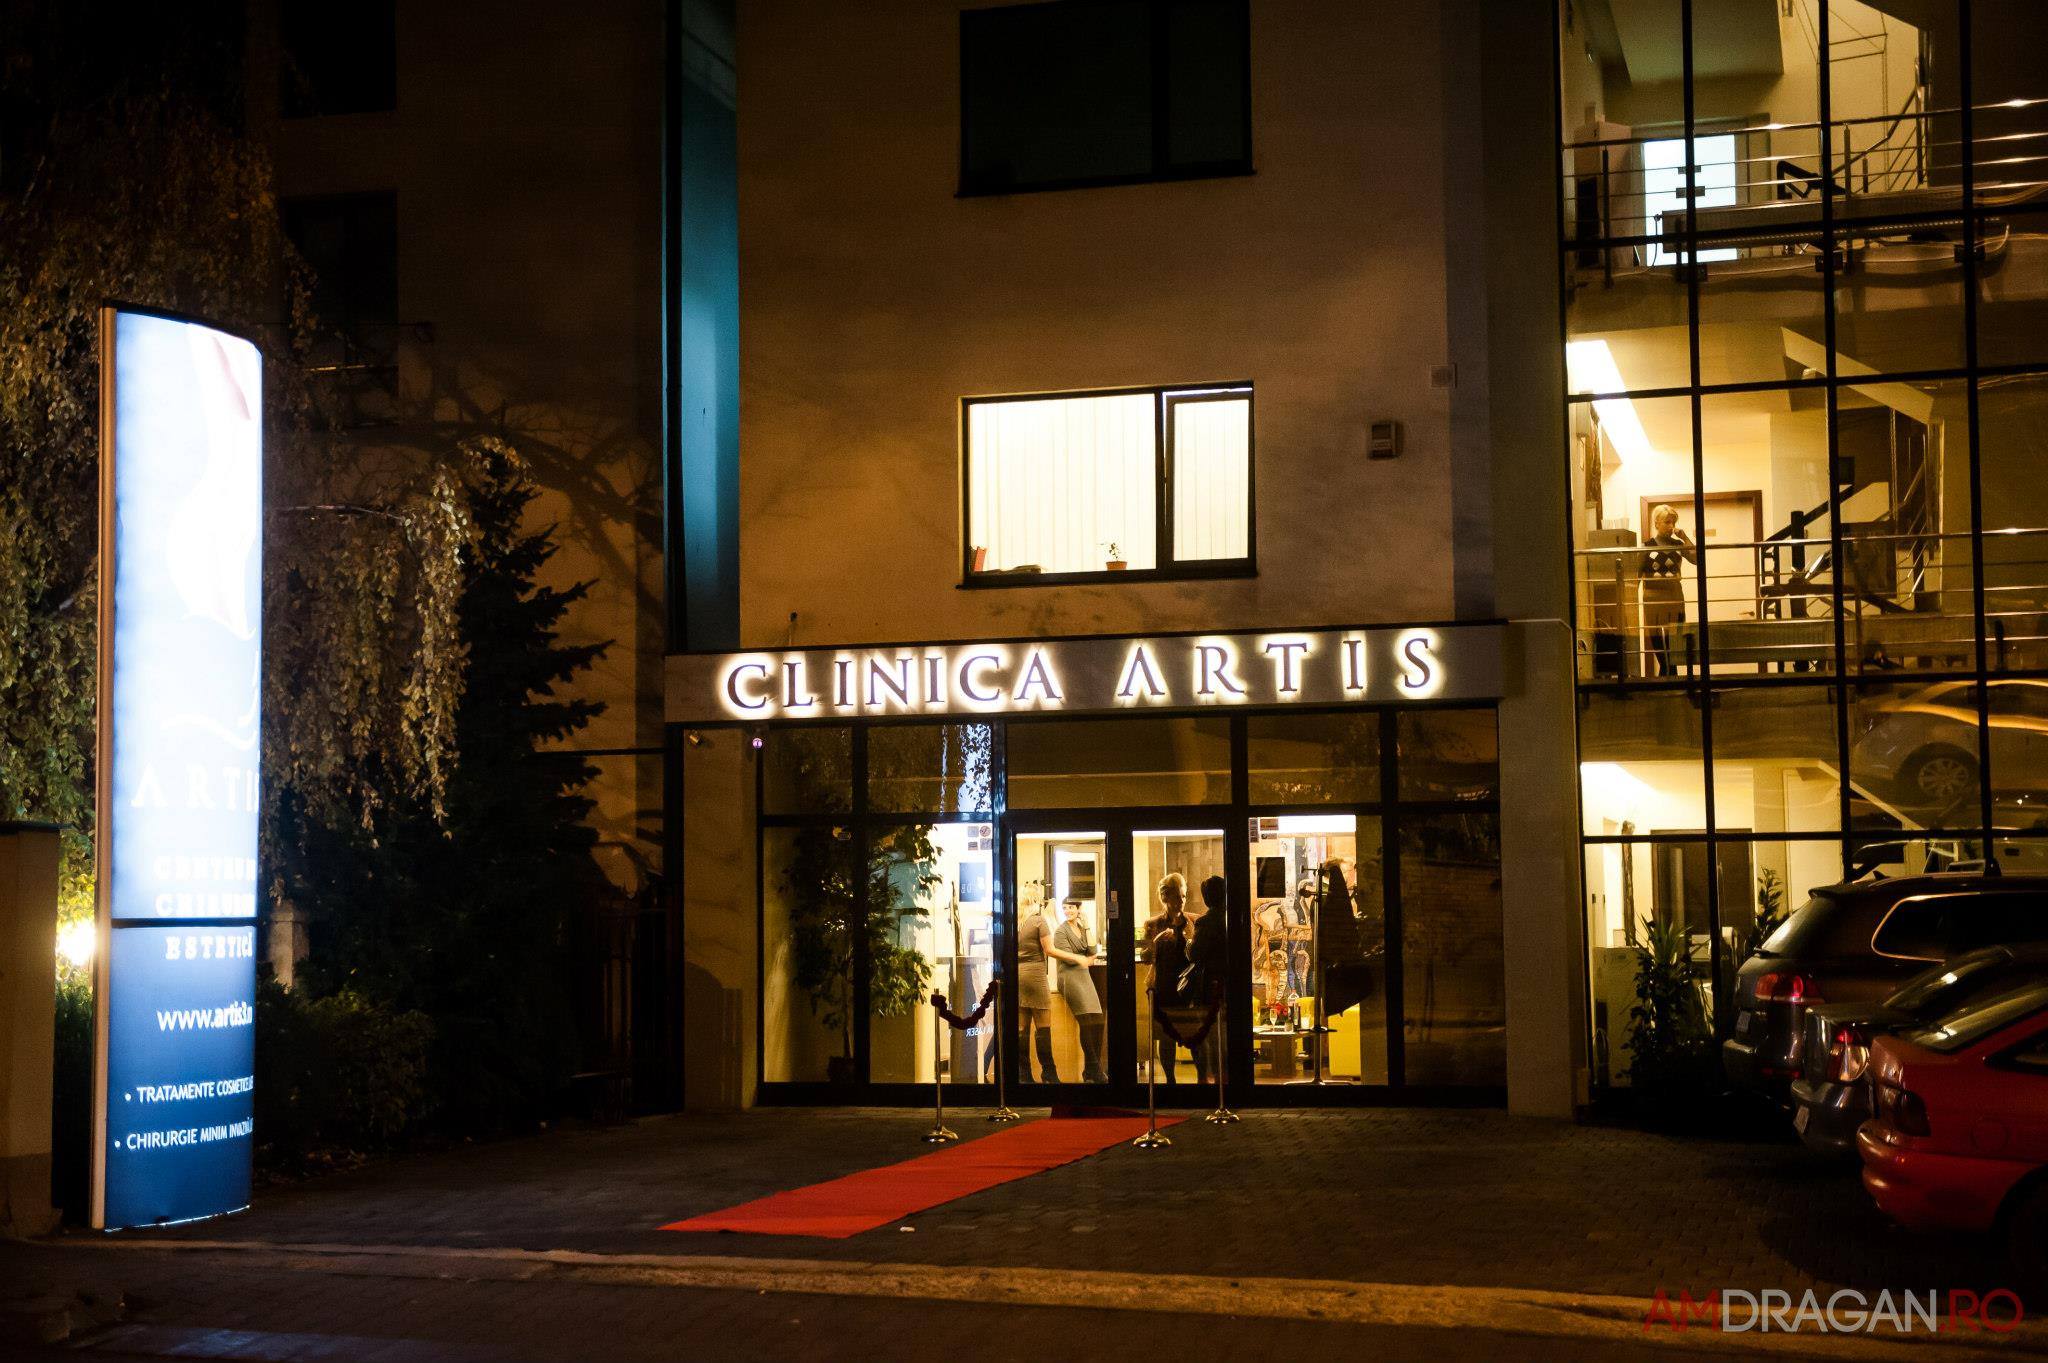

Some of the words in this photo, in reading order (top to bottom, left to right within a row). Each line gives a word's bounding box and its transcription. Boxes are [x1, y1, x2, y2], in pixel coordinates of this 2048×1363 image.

[727, 649, 1063, 710] CLINICA
[1117, 636, 1432, 699] ARTIS
[136, 1081, 215, 1103] TRATAMENTE
[126, 1128, 198, 1151] CHIRURGIE
[200, 1124, 228, 1143] MINIM
